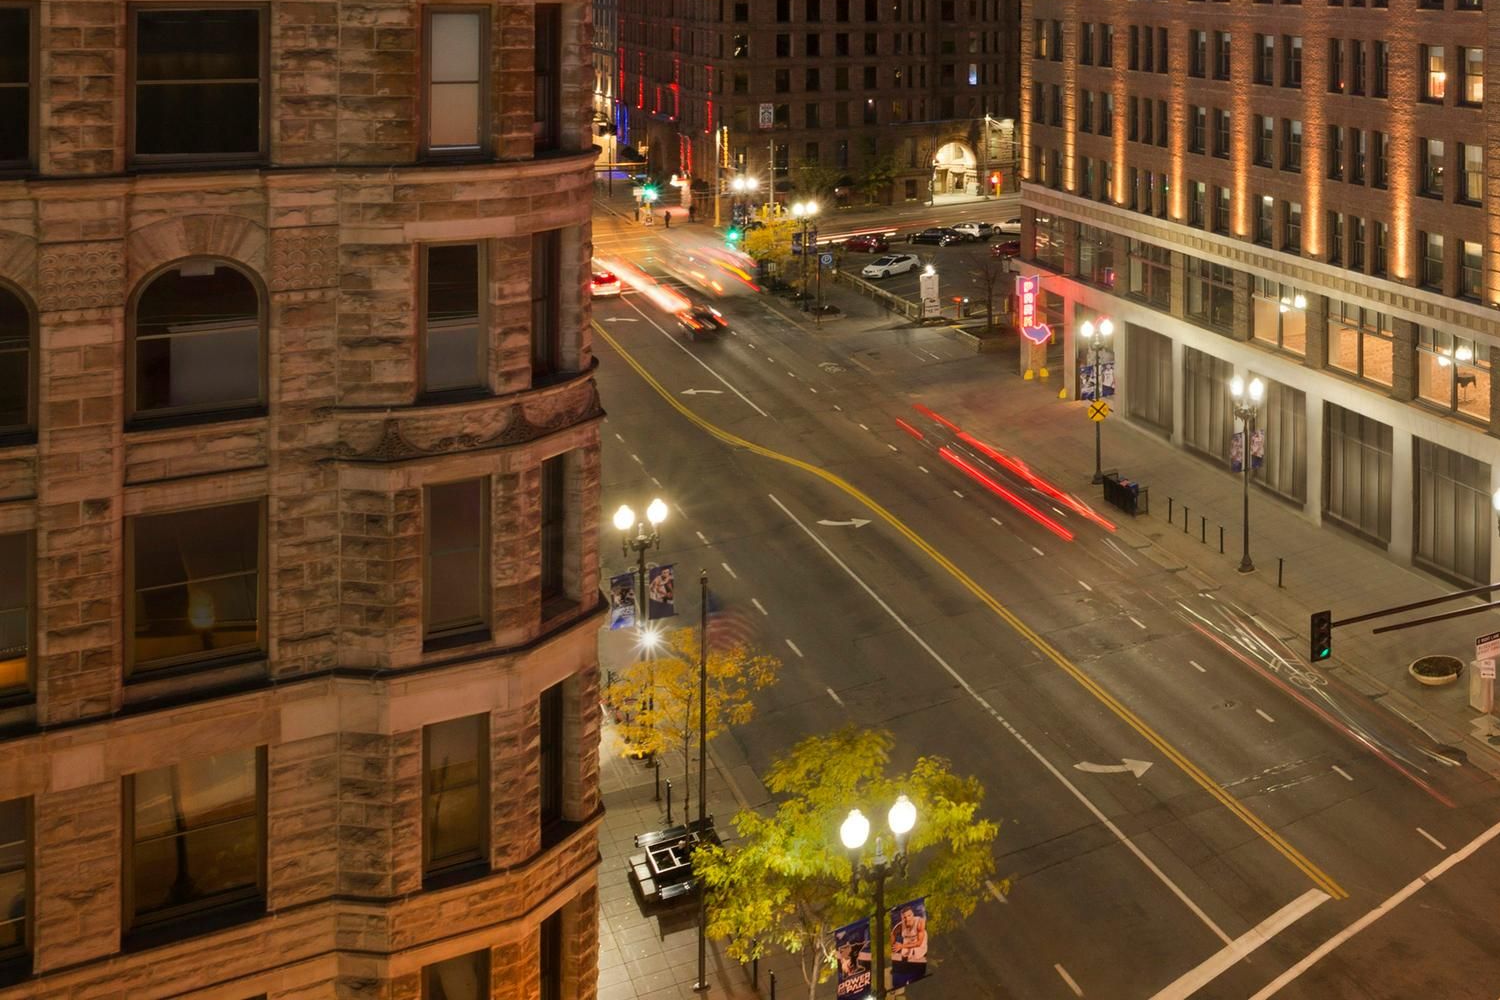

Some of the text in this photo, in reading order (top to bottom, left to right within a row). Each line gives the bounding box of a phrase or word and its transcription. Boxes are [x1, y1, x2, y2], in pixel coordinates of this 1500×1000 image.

[1023, 281, 1034, 327] PARK
[838, 971, 871, 993] POWER
[846, 978, 871, 993] PACK
